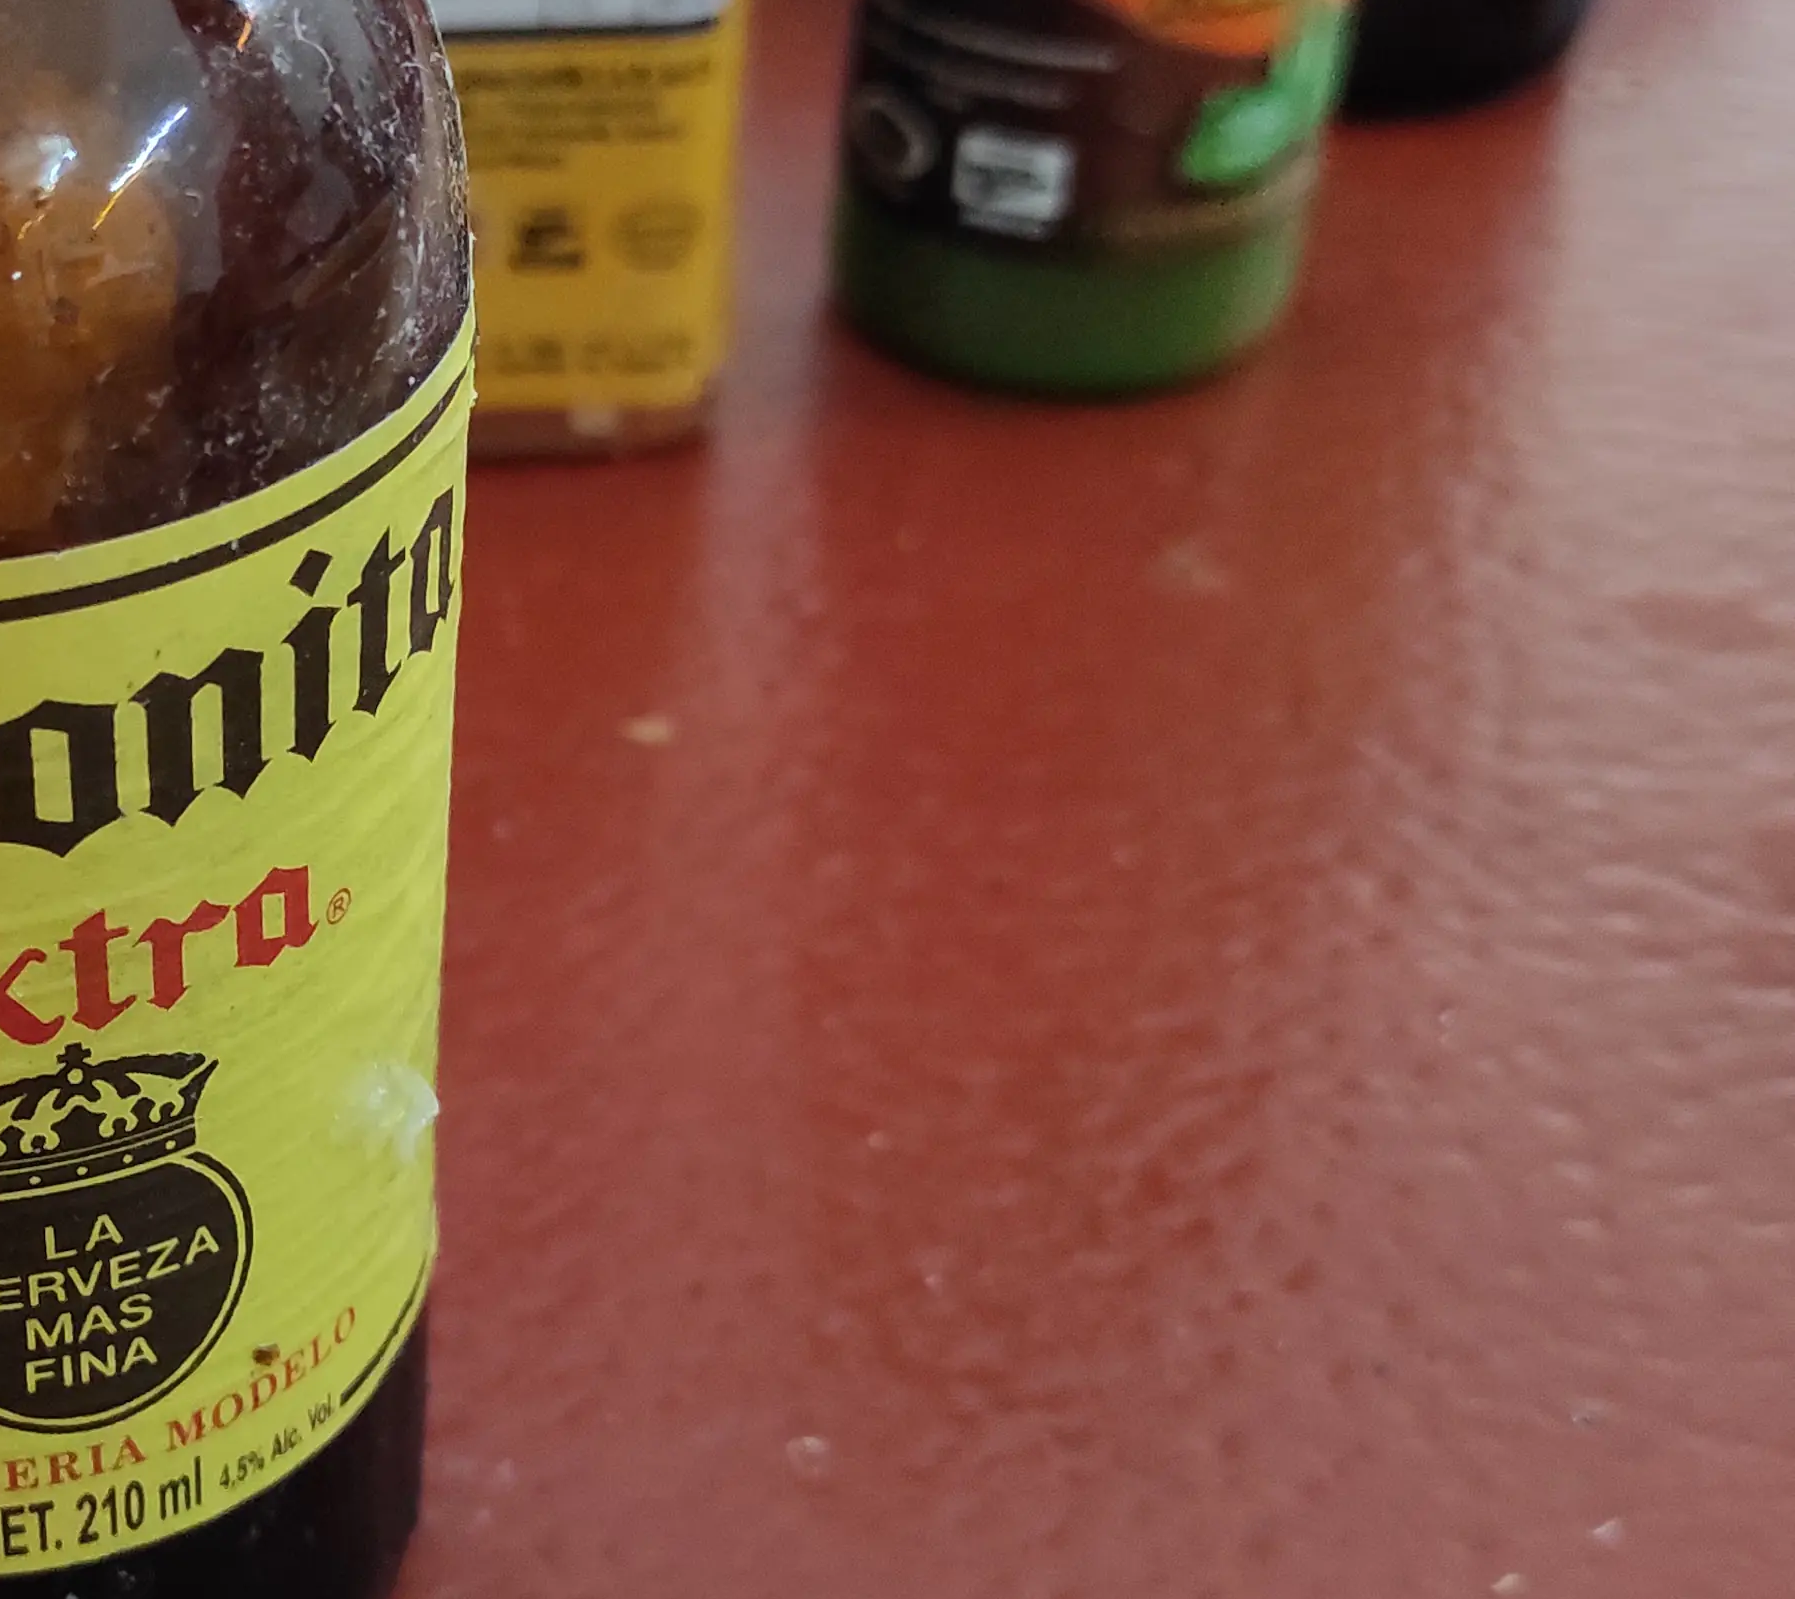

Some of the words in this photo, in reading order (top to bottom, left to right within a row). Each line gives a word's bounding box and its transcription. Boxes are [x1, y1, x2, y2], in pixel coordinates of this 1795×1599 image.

[44, 1214, 124, 1261] LA
[25, 1293, 154, 1351] MAS
[25, 1336, 157, 1394] FINA
[165, 1305, 357, 1453] MODELO
[77, 1478, 146, 1546] 210
[158, 1455, 202, 1522] ml
